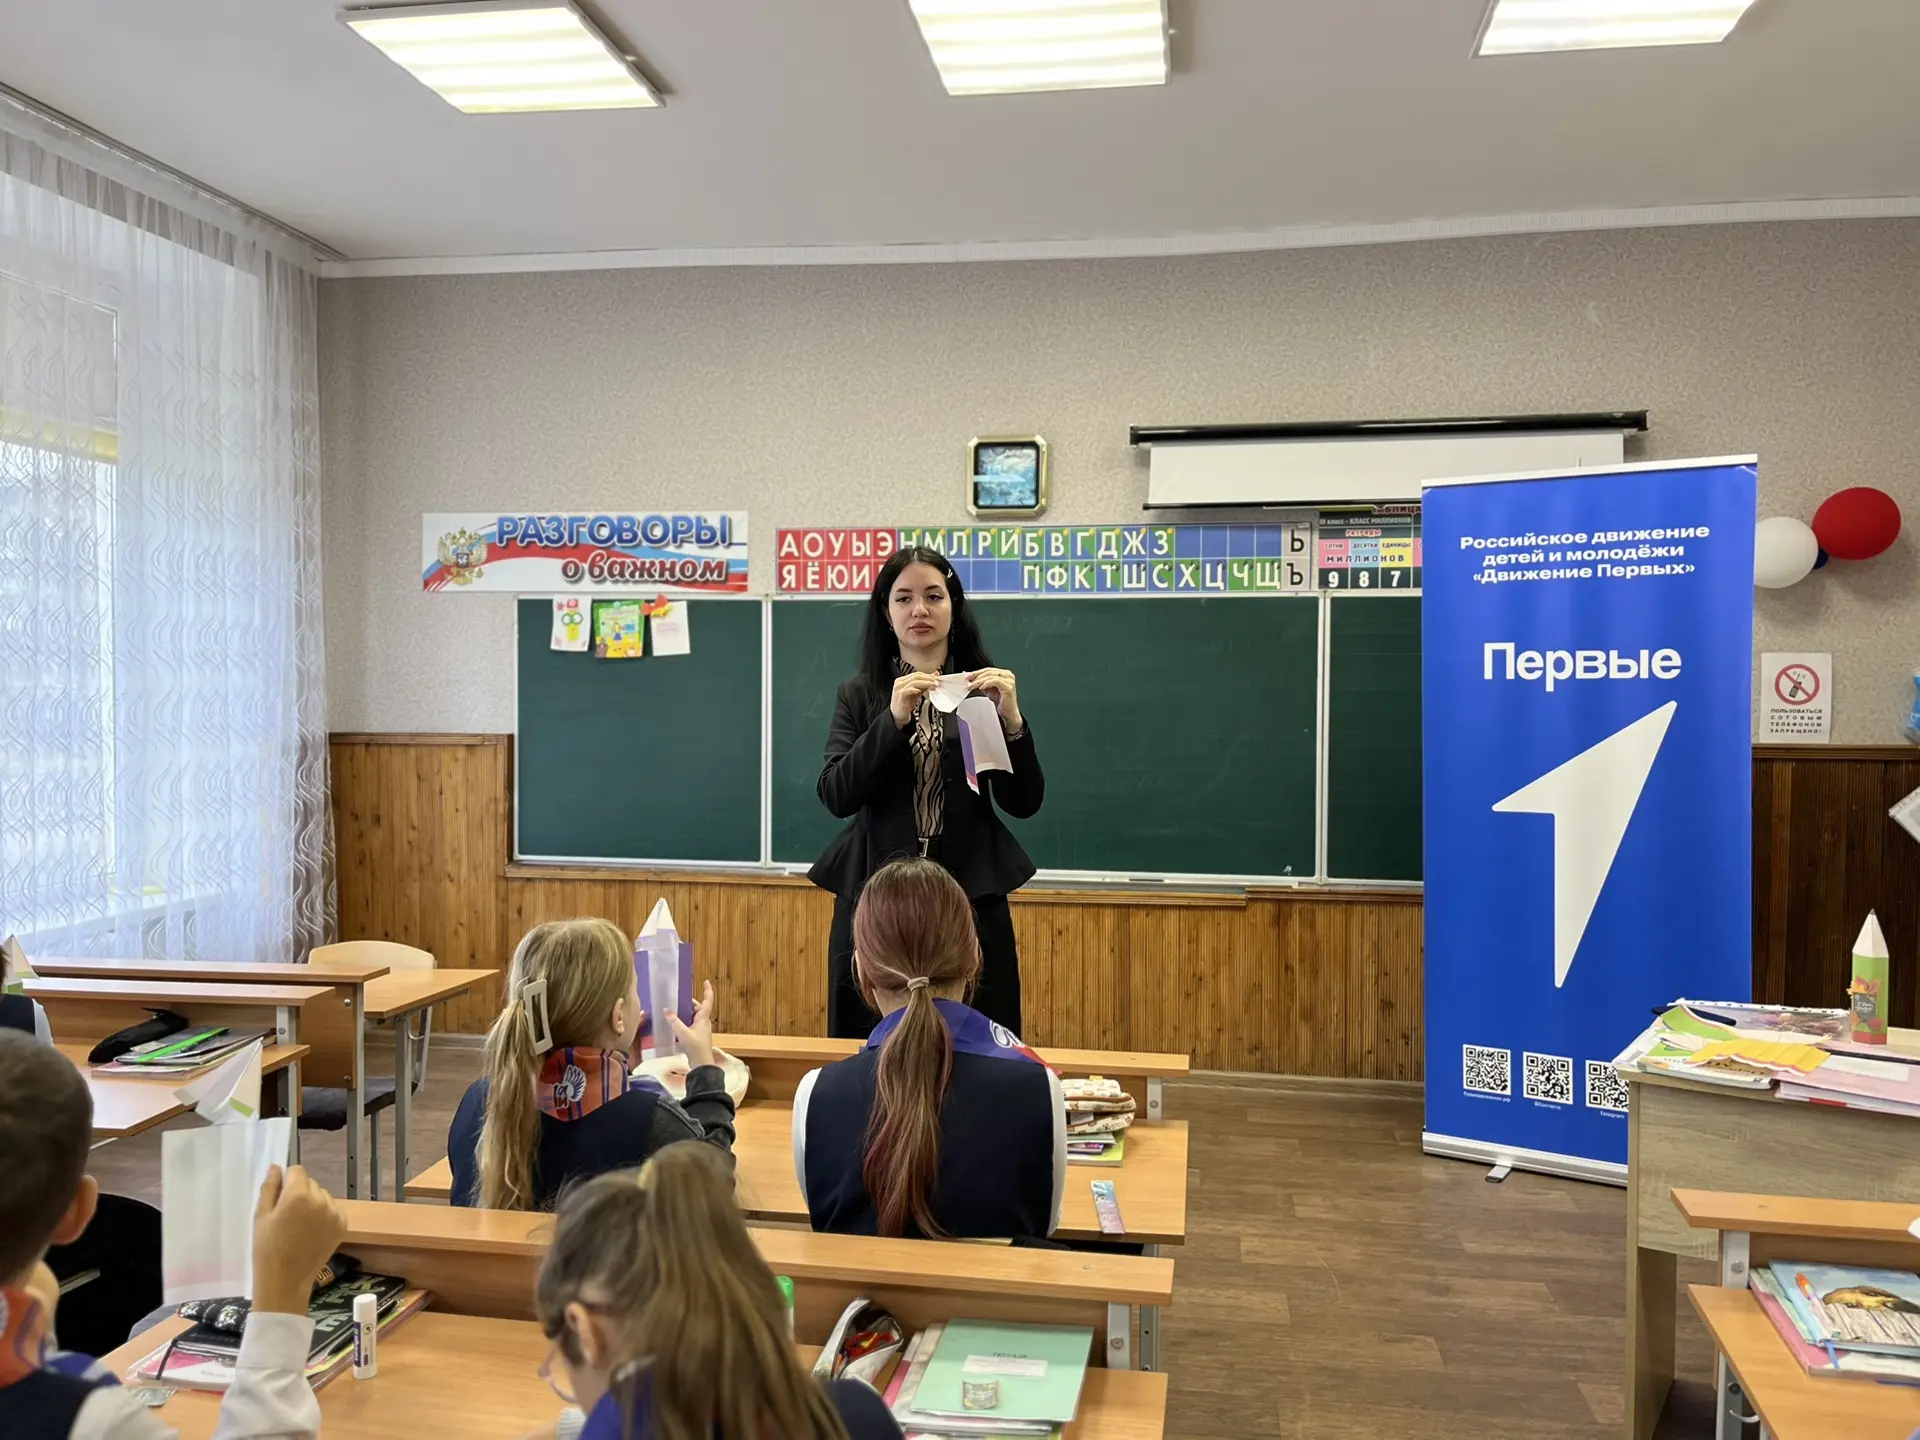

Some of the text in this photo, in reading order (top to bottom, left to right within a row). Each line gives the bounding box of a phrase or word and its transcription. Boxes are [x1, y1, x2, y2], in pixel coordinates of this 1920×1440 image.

[497, 515, 731, 547] РАЗГОВОРЫ
[780, 533, 800, 557] А
[803, 532, 824, 558] О
[826, 533, 845, 557] У
[852, 533, 870, 556] Ы
[876, 533, 893, 557] Э
[950, 533, 968, 556] Л
[979, 533, 992, 556] Р
[1001, 527, 1019, 556] Й
[1025, 530, 1038, 557] Б
[1051, 532, 1064, 557] В
[1076, 531, 1090, 556] Г
[1098, 531, 1118, 559] Д
[1123, 531, 1146, 555] Ж
[1153, 530, 1168, 555] З
[1290, 528, 1305, 552] Ь
[1460, 526, 1710, 549] Российское движение
[561, 551, 729, 581] о важном
[1326, 554, 1404, 563] МИЛЛИОНОВ
[1483, 545, 1684, 567] детей и молодёжи
[782, 564, 796, 588] Я
[807, 562, 820, 588] Ё
[828, 564, 848, 589] Ю
[853, 564, 870, 588] И
[1023, 565, 1040, 588] П
[1046, 564, 1067, 589] Ф
[1075, 565, 1091, 588] К
[1101, 565, 1117, 588] Т
[1123, 564, 1146, 588] Ш
[1152, 565, 1169, 588] С
[1179, 565, 1196, 587] Х
[1205, 564, 1224, 590] Ц
[1232, 564, 1249, 587] Ч
[1256, 564, 1280, 590] Щ
[1286, 563, 1304, 586] Ъ
[1328, 570, 1401, 588] 9 8 7
[1473, 562, 1696, 584] «Движение Первых»
[1482, 642, 1682, 692] Первые
